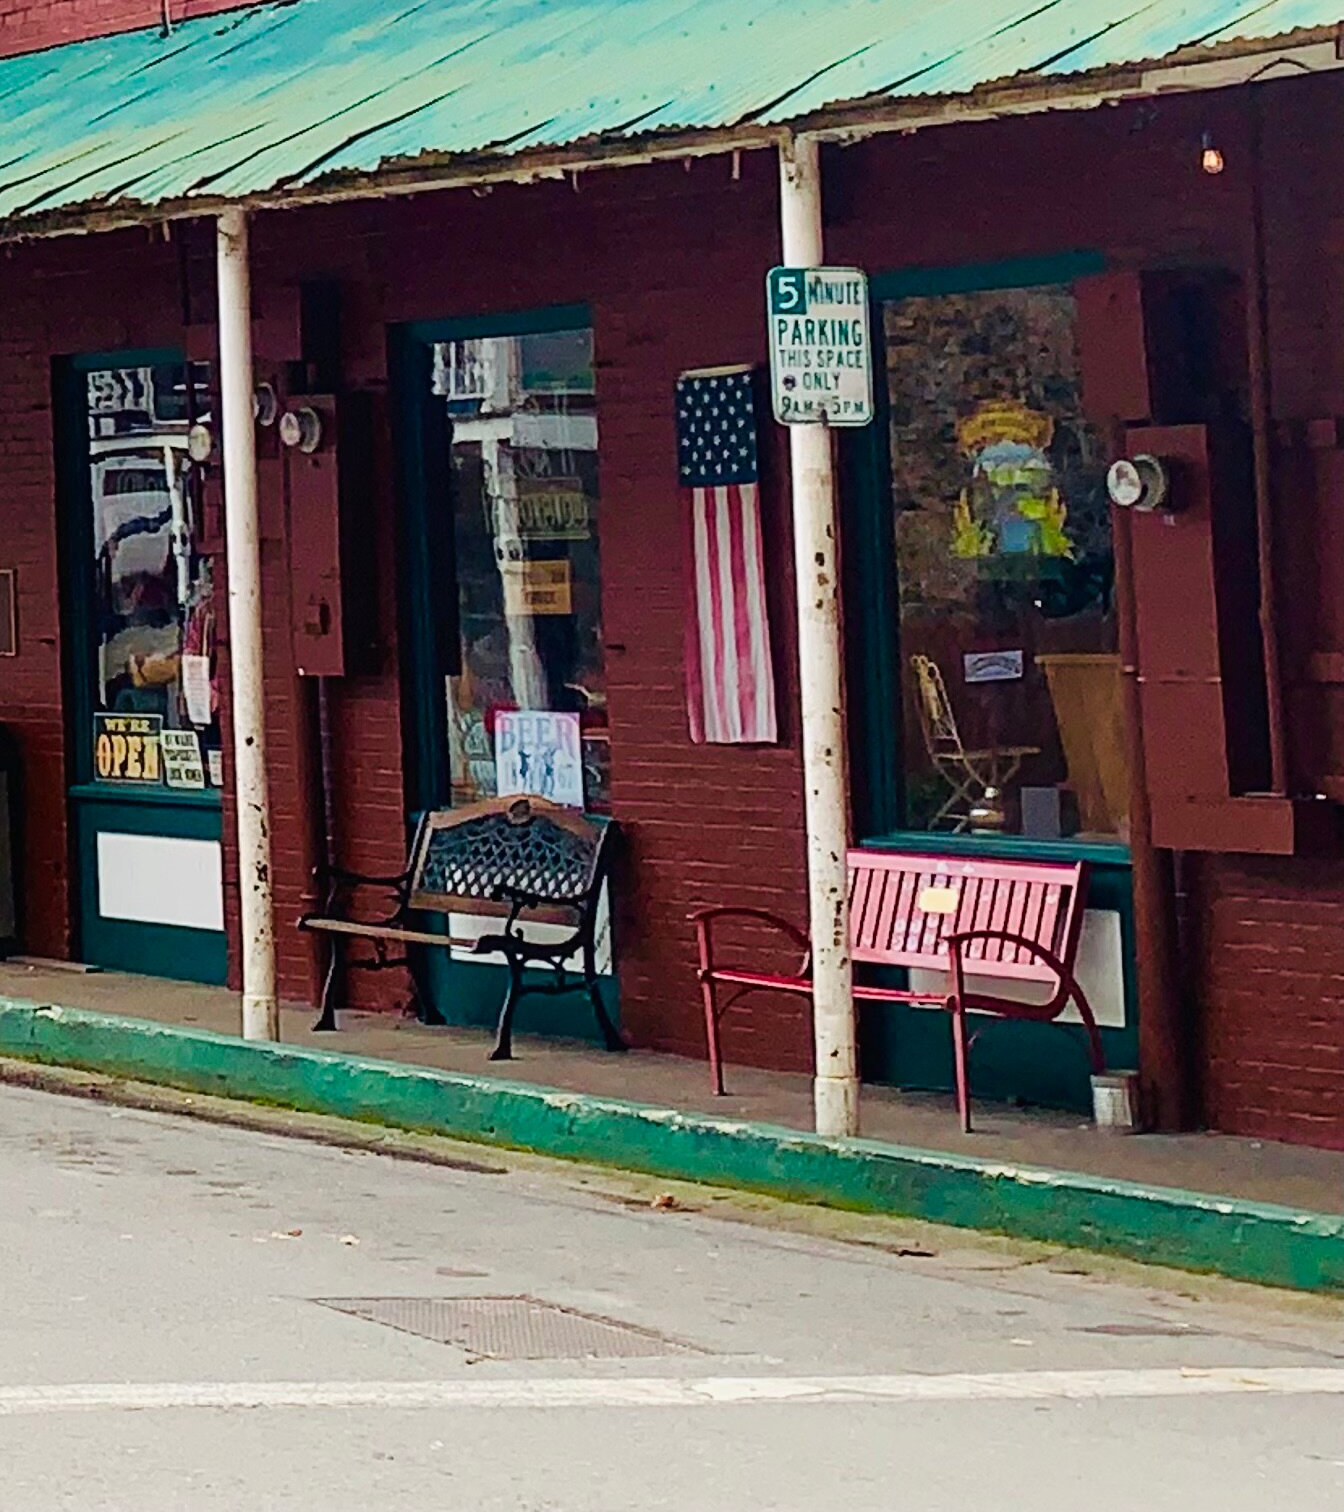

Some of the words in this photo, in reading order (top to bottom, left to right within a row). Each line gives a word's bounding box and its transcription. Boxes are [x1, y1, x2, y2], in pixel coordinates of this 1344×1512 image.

[778, 277, 799, 309] 5
[808, 282, 862, 305] MINUTE
[778, 319, 863, 346] PARKING
[779, 349, 811, 368] THIS
[817, 349, 863, 368] SPACE
[802, 372, 840, 391] ONLY
[501, 716, 577, 762] BEER
[97, 734, 160, 779] OPEN
